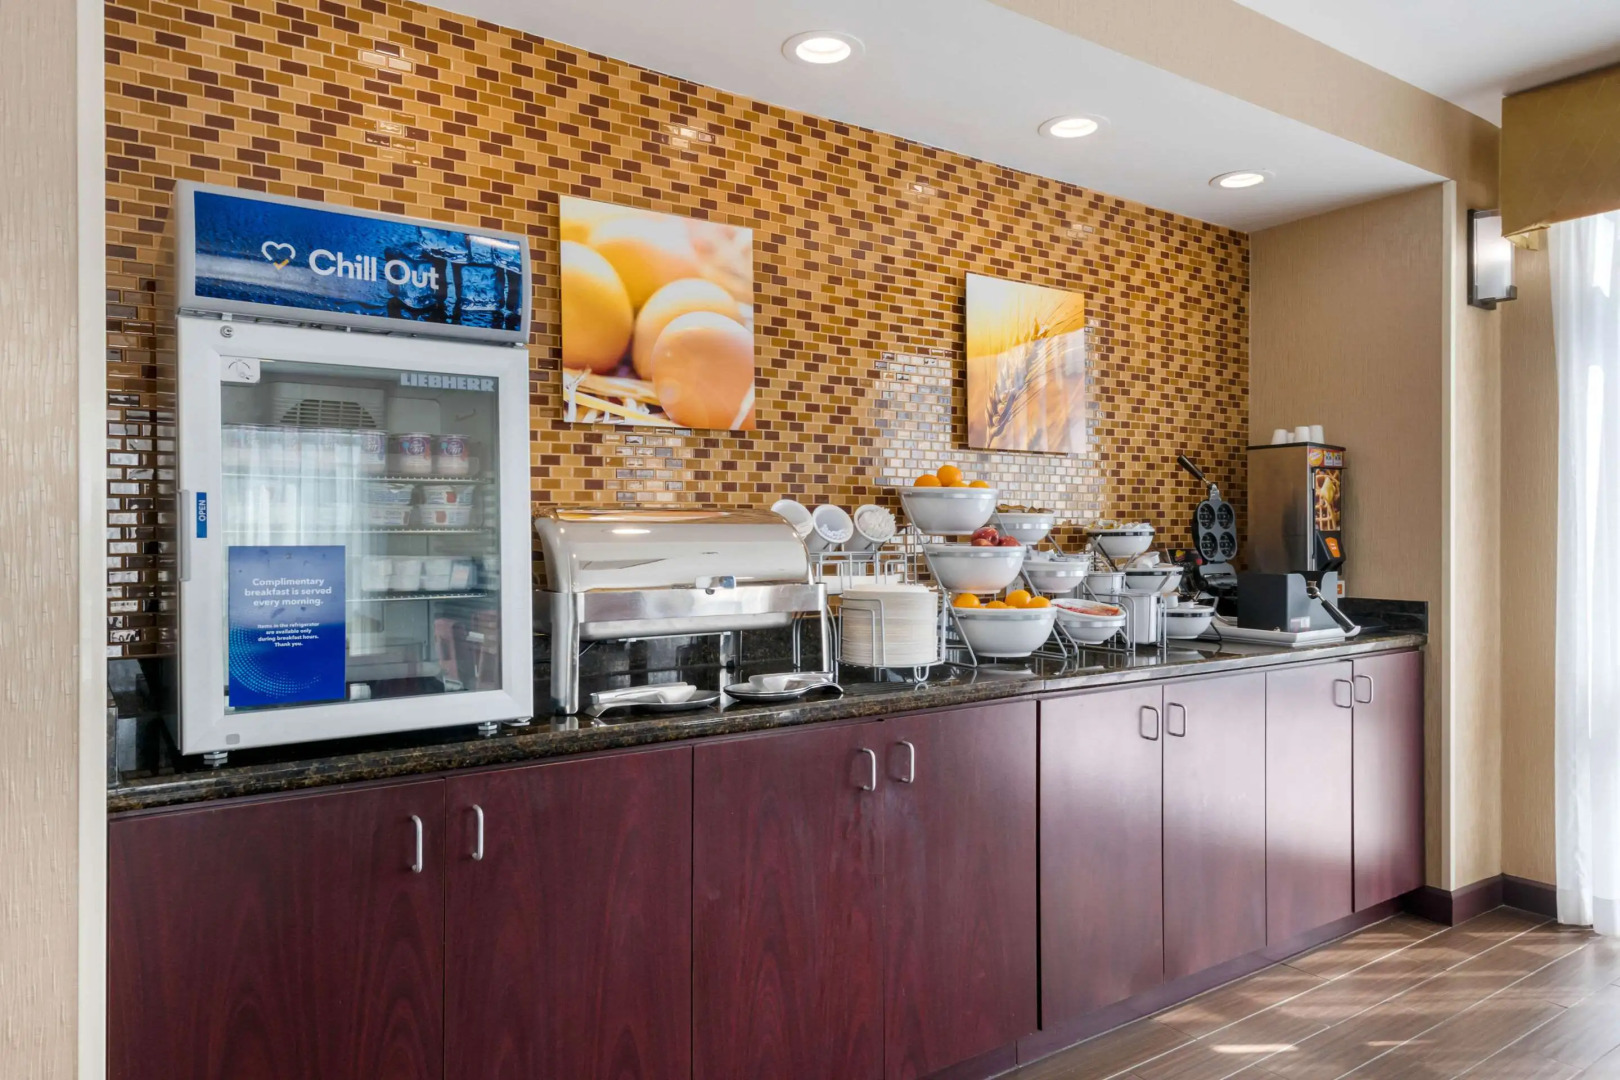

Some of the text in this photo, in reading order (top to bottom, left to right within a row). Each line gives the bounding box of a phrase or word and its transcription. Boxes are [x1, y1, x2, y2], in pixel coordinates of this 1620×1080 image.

[308, 248, 439, 290] Chill Out
[400, 372, 496, 392] LIEBHERR
[198, 499, 207, 522] OPEN
[252, 577, 325, 587] Complimentary
[244, 588, 290, 596] breakfast
[301, 586, 332, 595] served
[253, 597, 324, 607] every morning.
